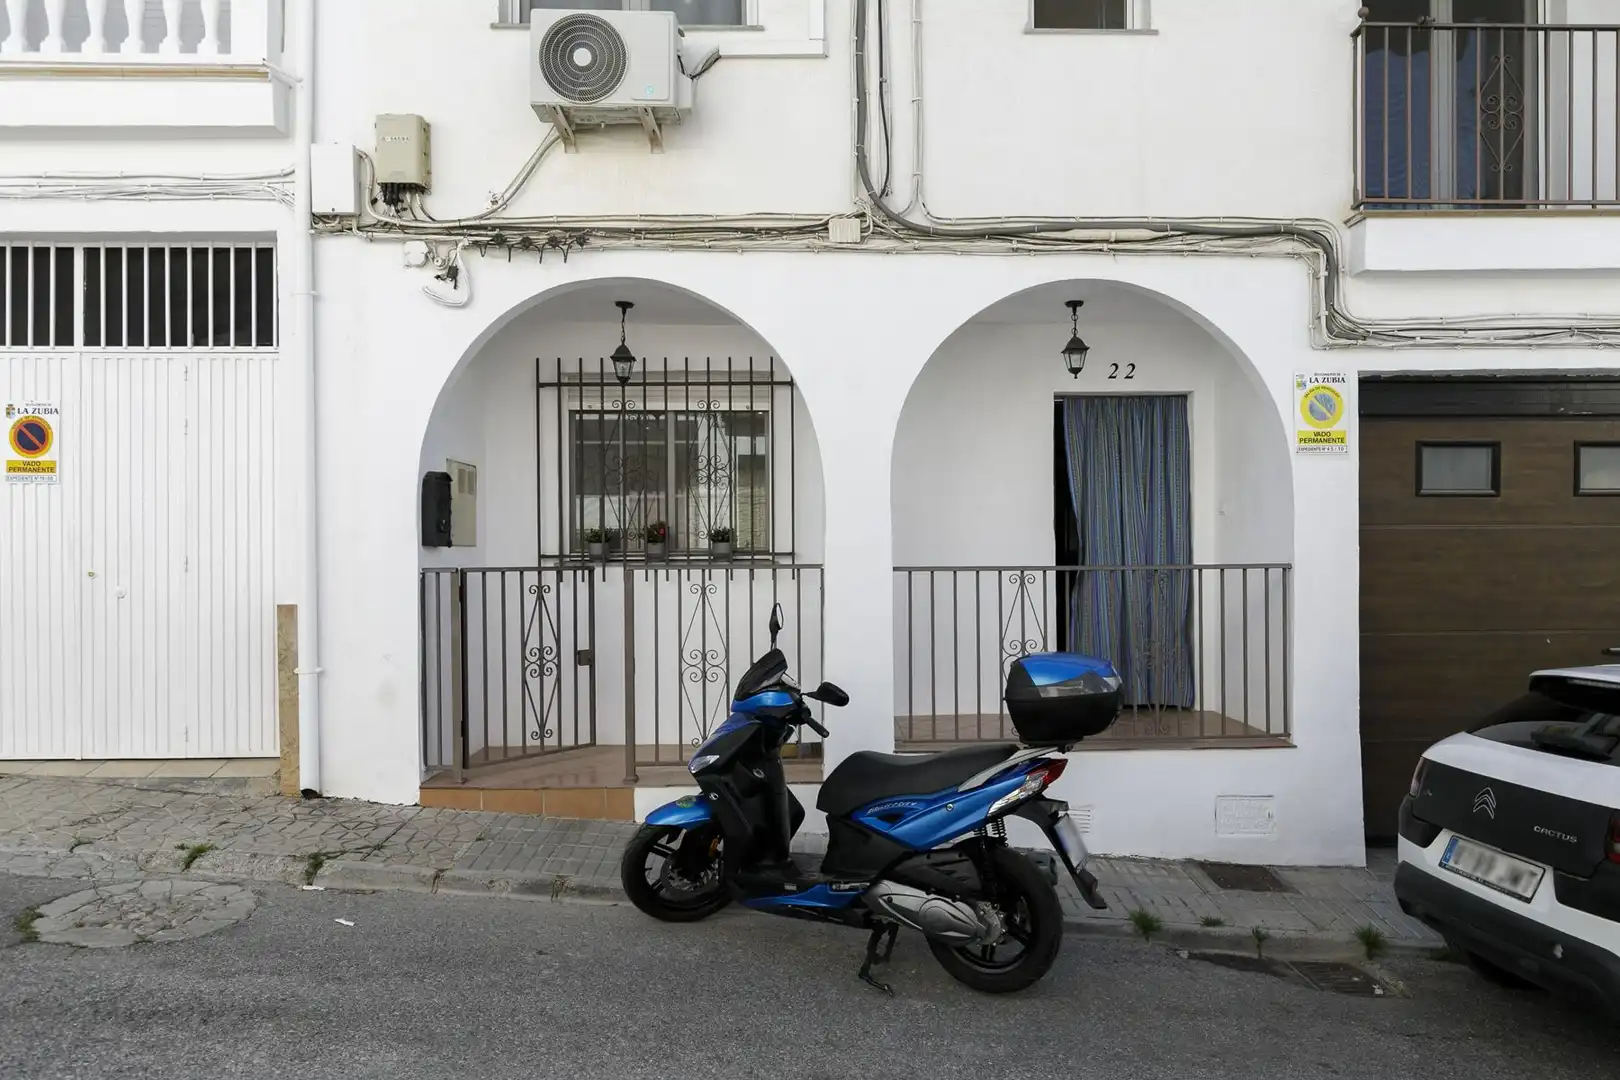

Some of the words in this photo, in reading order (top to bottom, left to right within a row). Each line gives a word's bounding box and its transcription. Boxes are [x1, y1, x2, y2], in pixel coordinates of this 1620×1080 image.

[1107, 362, 1136, 379] 22
[1309, 376, 1320, 384] LA
[1321, 376, 1346, 384] ZUBIA
[1533, 825, 1578, 843] CACTUS
